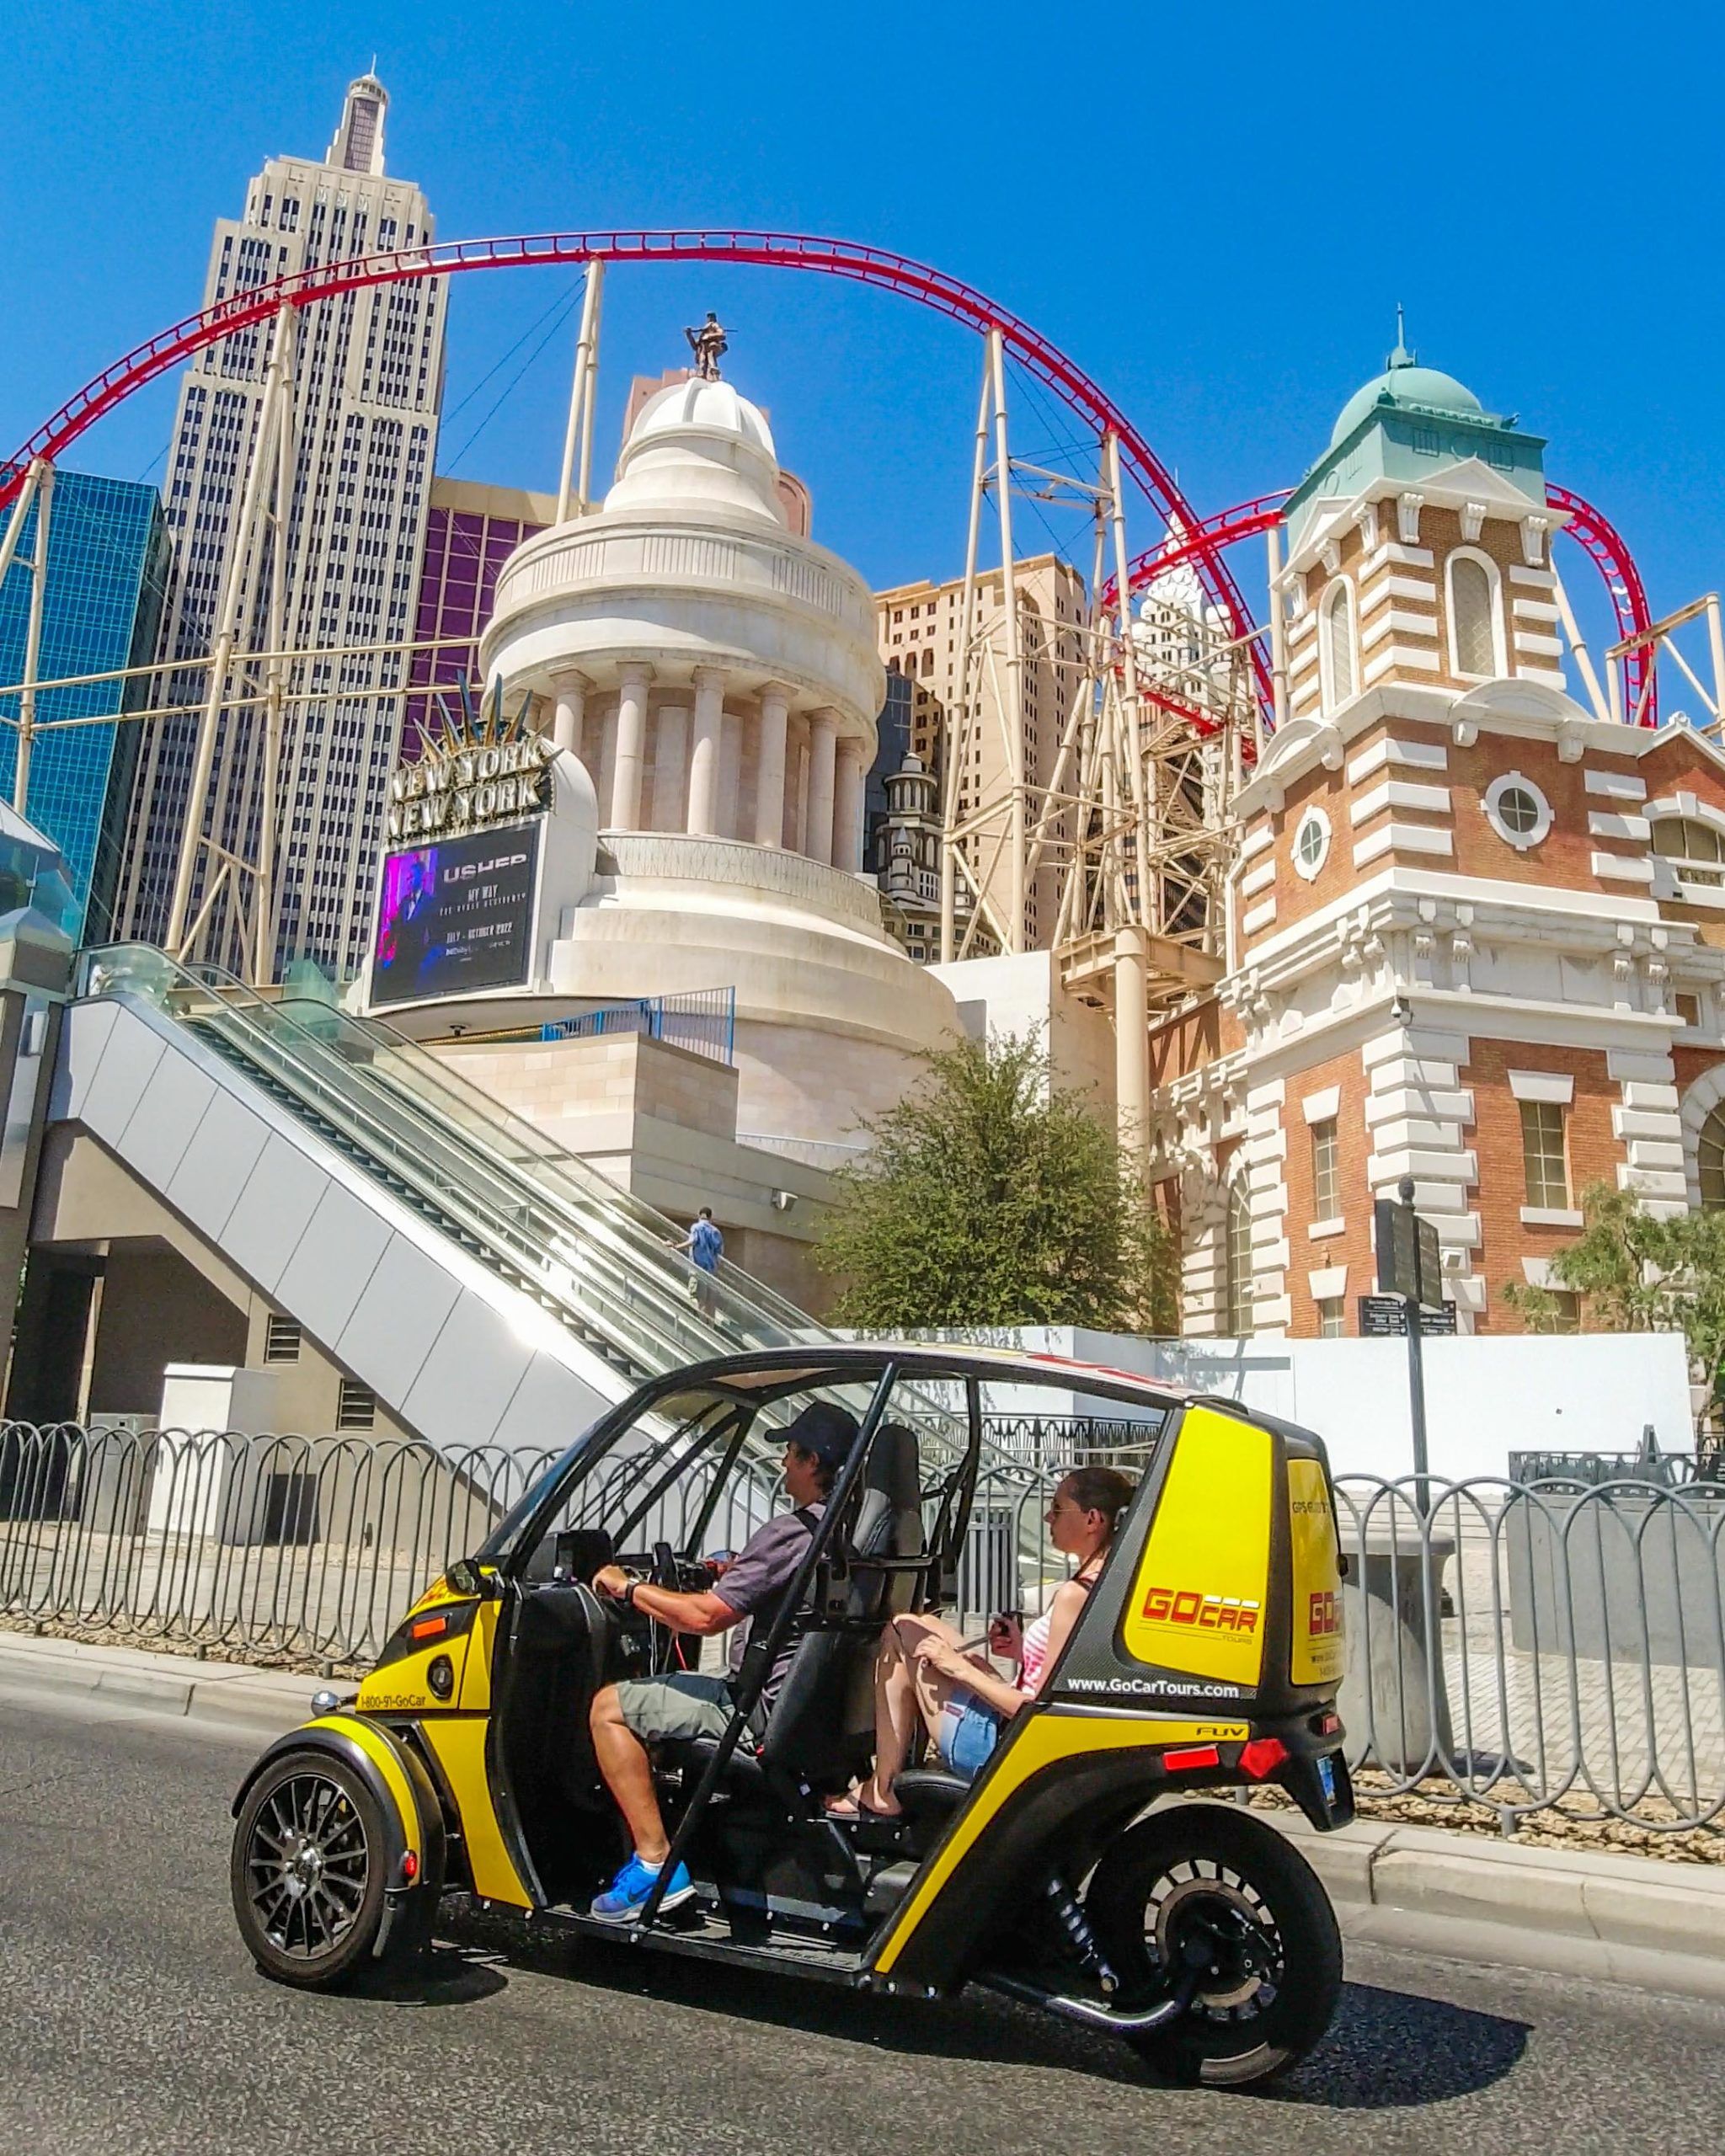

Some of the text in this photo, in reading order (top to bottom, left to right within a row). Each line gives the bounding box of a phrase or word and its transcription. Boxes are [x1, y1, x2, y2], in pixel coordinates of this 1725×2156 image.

[393, 739, 543, 801] NEW YORK
[387, 772, 542, 837] NEW YORK
[482, 884, 499, 899] WAY
[1222, 1634, 1253, 1646] TOURS
[1067, 1676, 1240, 1699] www.GoCarTours.com
[360, 1694, 426, 1708] 1-800-91-GoCar
[1196, 1725, 1246, 1737] FUV
